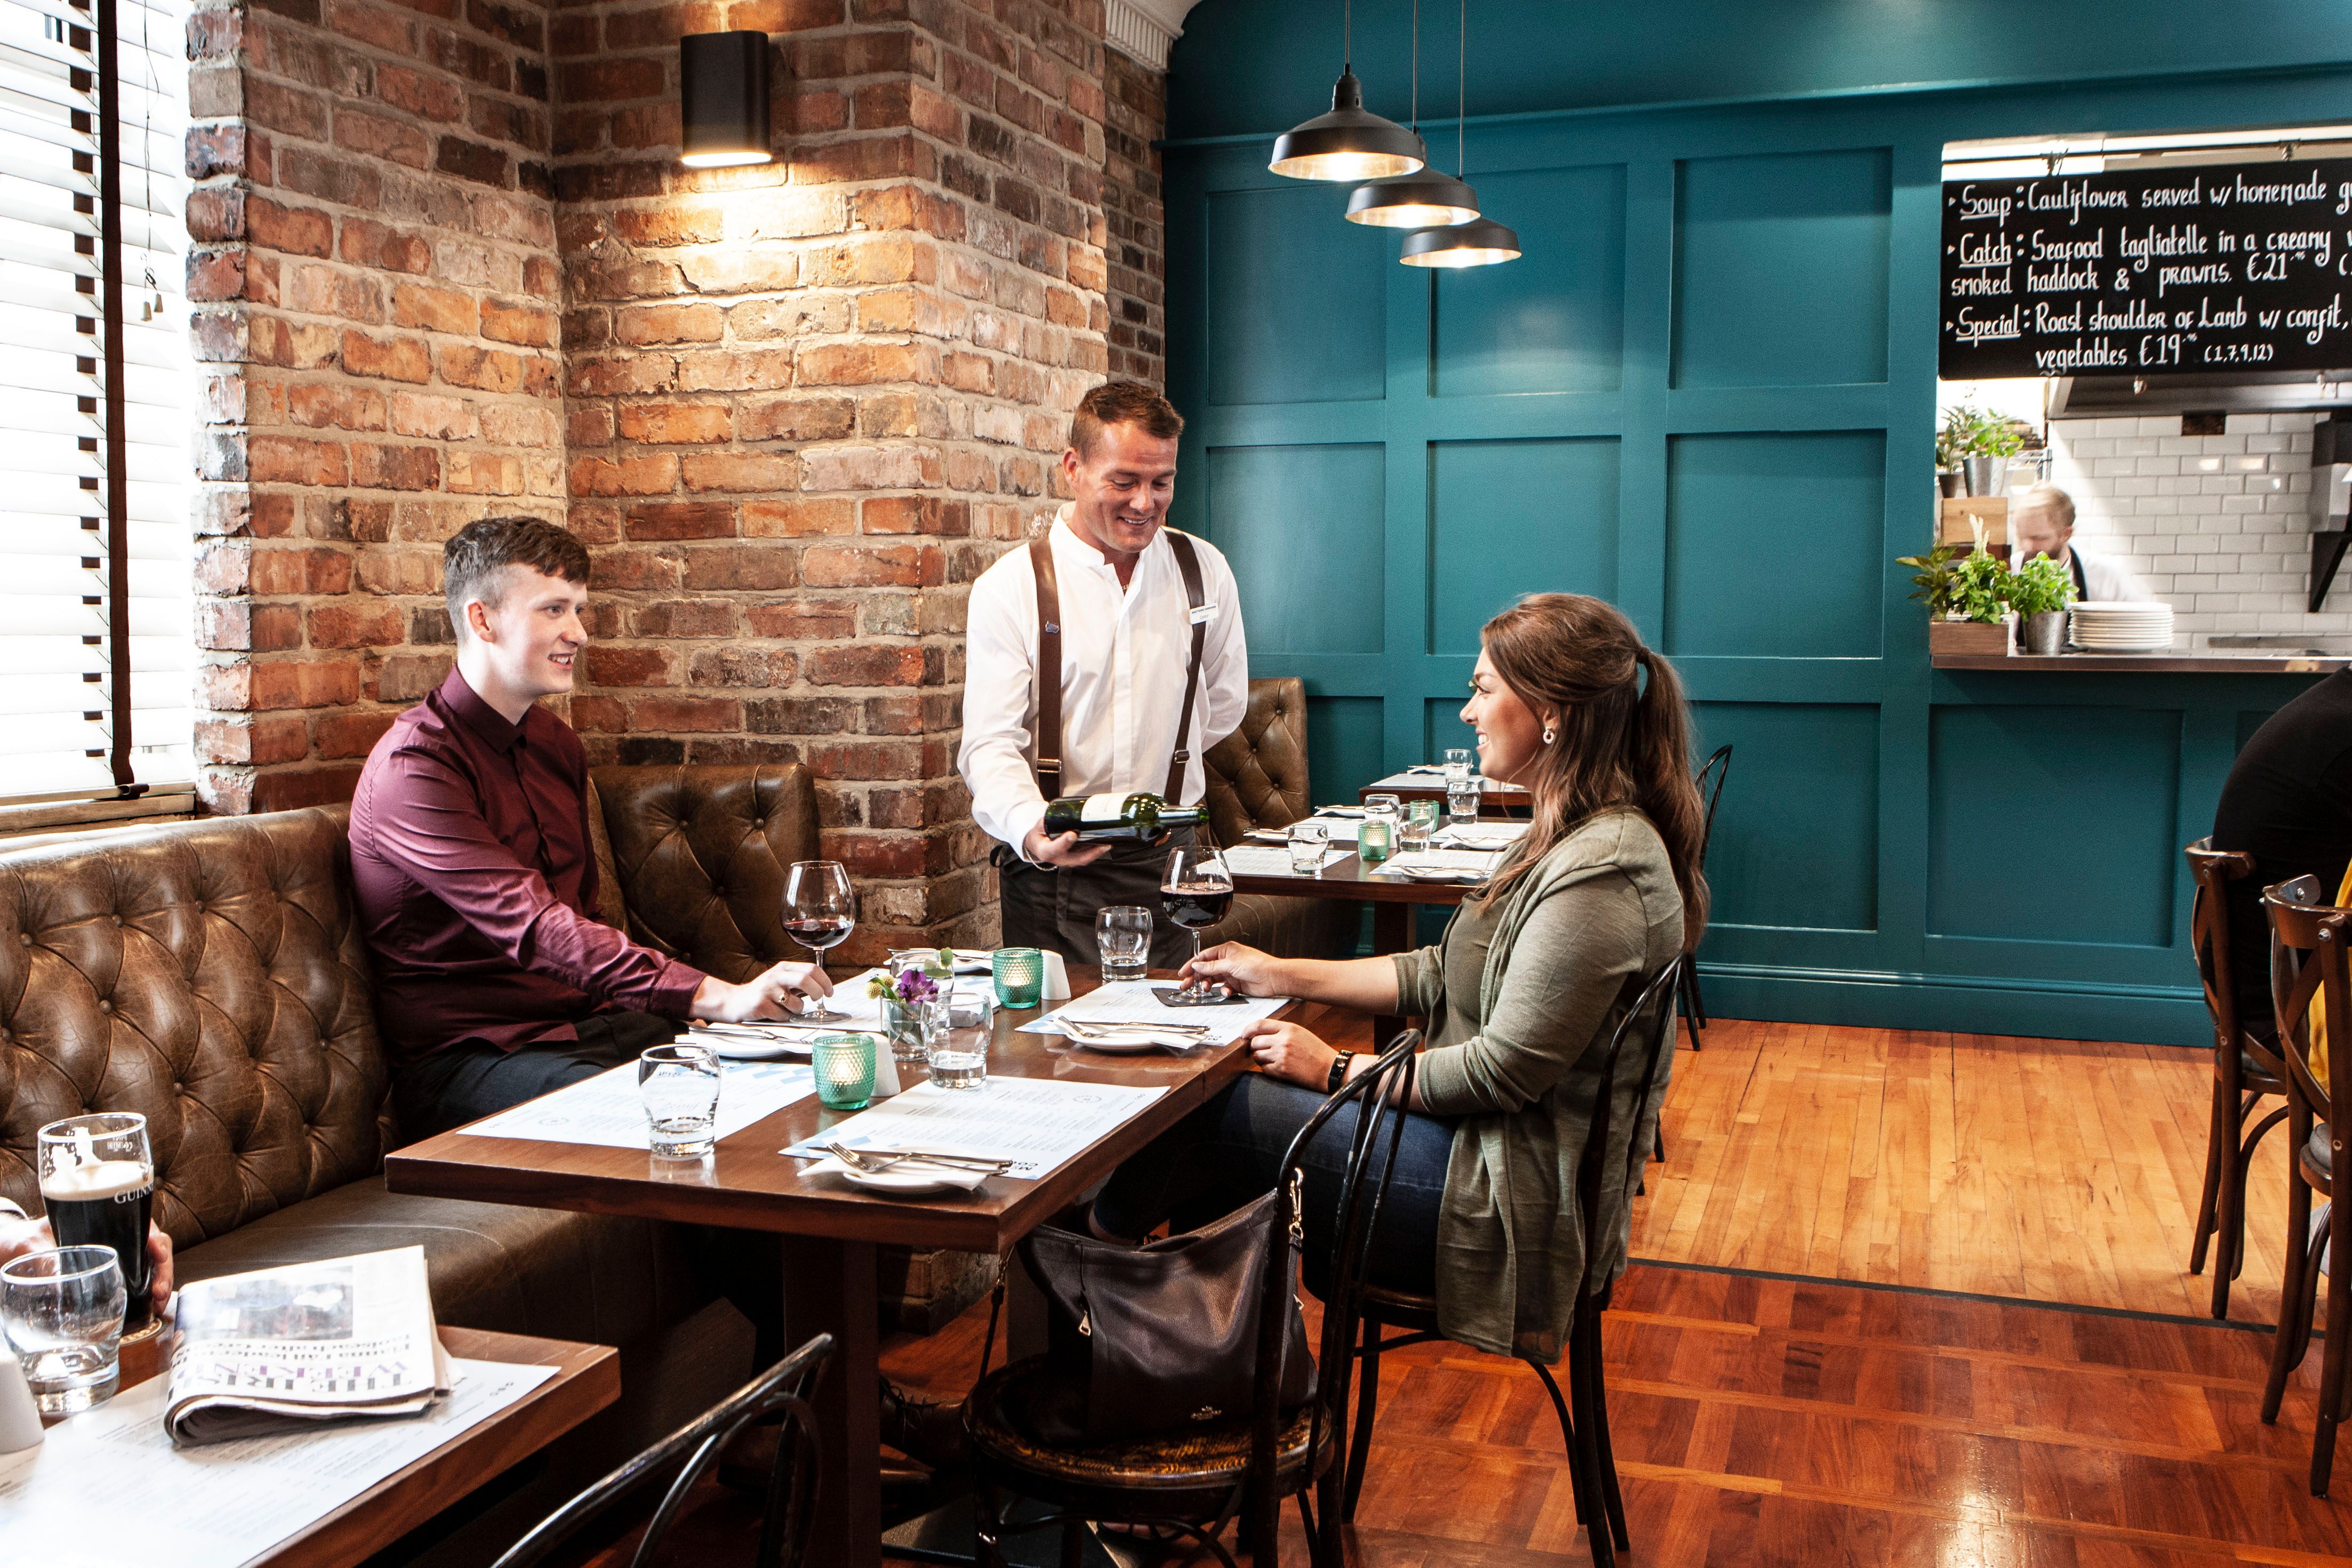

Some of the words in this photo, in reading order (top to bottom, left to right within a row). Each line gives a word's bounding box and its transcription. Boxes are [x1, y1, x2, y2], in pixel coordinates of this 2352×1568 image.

[2028, 179, 2129, 226] Cauliflower
[2142, 176, 2201, 208] served
[2210, 186, 2233, 207] w/
[2236, 168, 2327, 206] homemade
[2031, 227, 2104, 263] Seafood
[2120, 224, 2208, 273] tagliatelle
[2218, 230, 2236, 253] in
[2244, 234, 2258, 251] a
[2266, 230, 2331, 267] creamy
[1951, 267, 2013, 296] smoked
[2027, 260, 2100, 293] haddock
[2114, 268, 2130, 292] &
[2035, 300, 2083, 334] Roast
[2089, 297, 2168, 332] shoulder
[2174, 310, 2194, 330] of
[2197, 295, 2247, 329] Lamb
[2259, 309, 2281, 330] w/
[2286, 293, 2349, 345] confit,
[2035, 336, 2128, 374] vegetables
[114, 1182, 154, 1204] GUINN
